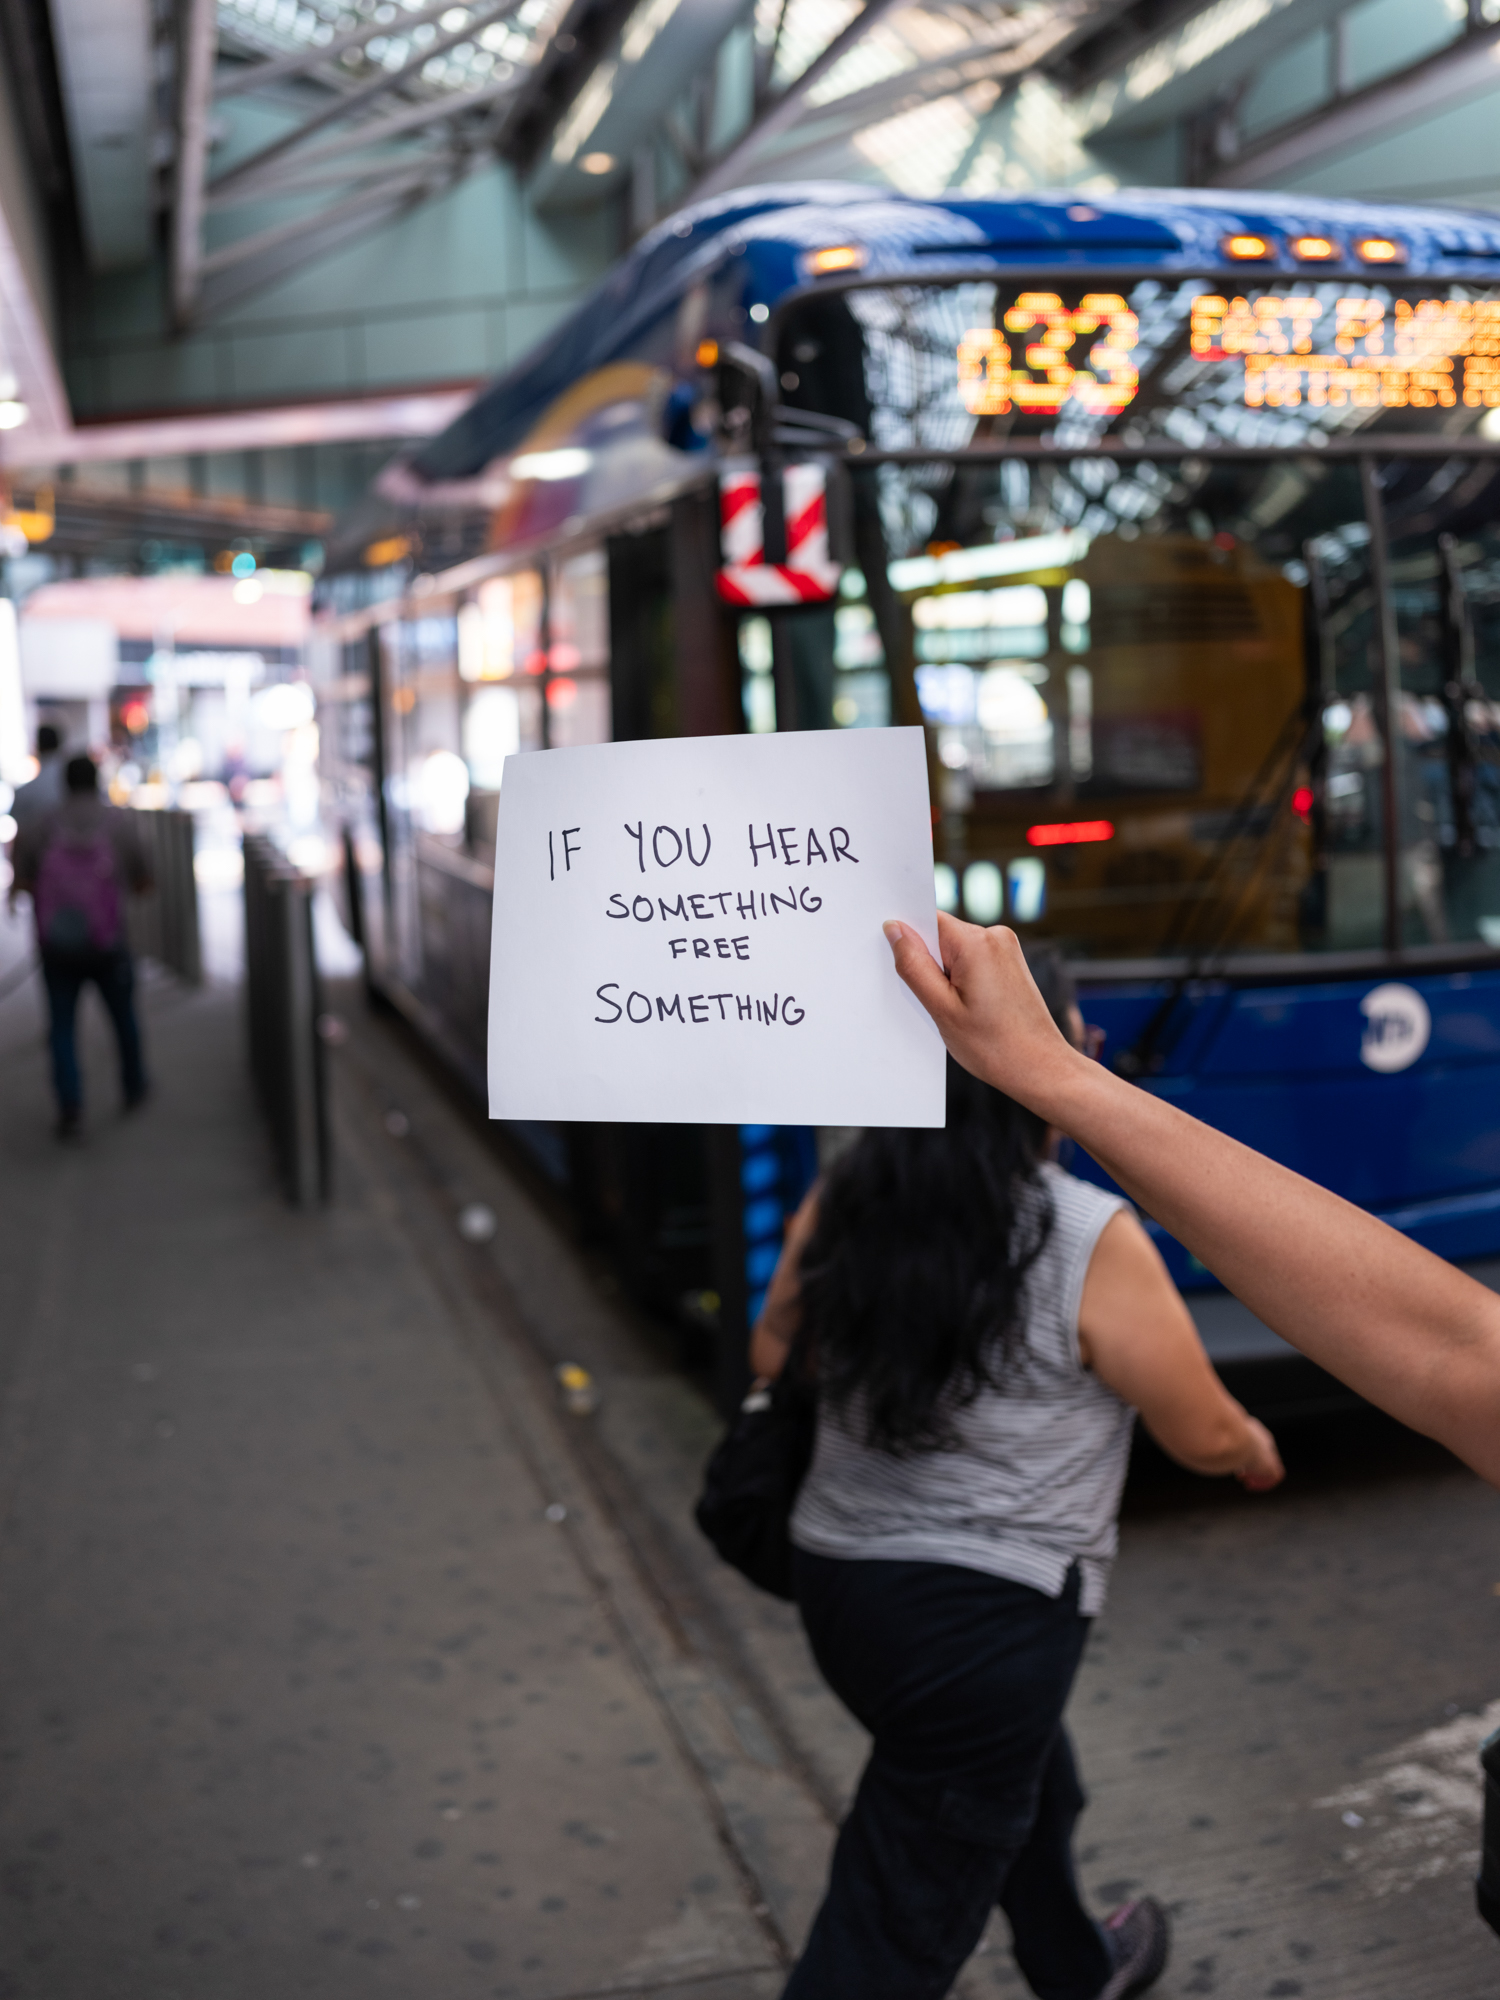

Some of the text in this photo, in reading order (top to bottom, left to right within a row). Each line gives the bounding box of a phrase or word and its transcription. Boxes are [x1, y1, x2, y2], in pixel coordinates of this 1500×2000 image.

[549, 821, 859, 881] IF YOU HEAR
[606, 886, 822, 922] SOMETHING
[668, 936, 750, 960] FREE
[595, 983, 805, 1026] SOMETHING
